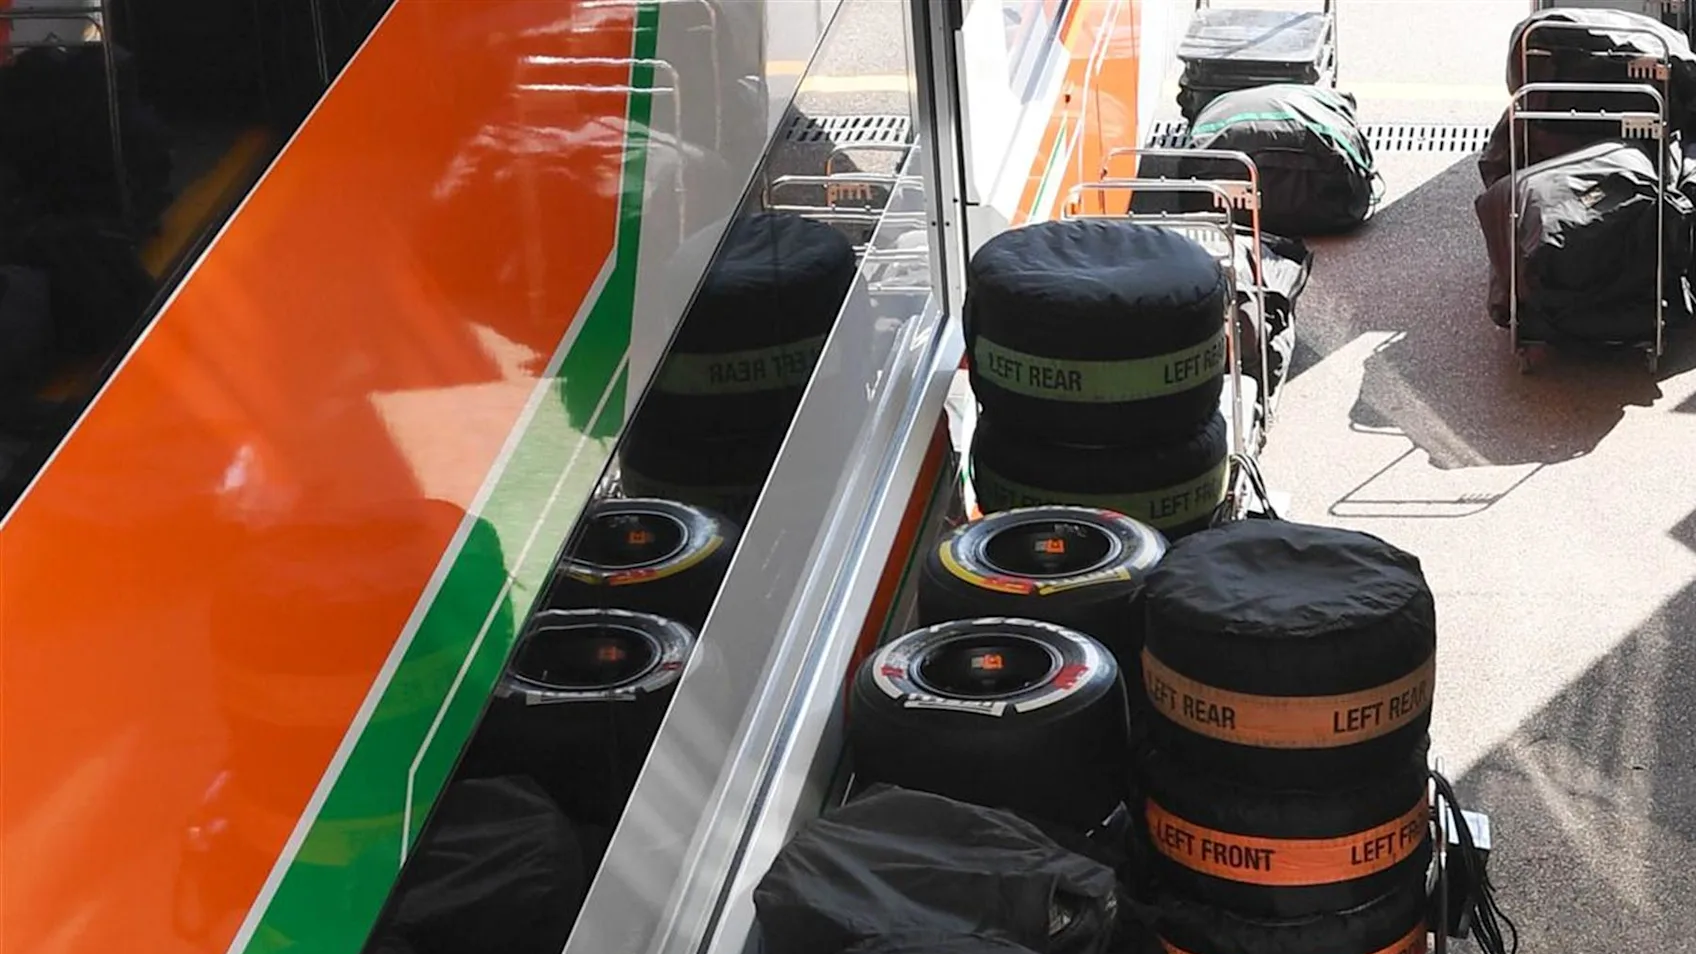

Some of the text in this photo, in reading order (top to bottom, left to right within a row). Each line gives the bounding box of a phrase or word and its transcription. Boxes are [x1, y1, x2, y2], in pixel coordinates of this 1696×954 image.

[988, 352, 1082, 391] LEFT REAR
[1164, 354, 1201, 384] LEFT
[1183, 693, 1236, 730] REAR
[1333, 679, 1426, 734] LEFT REAR
[1157, 818, 1276, 872] LEFT FRONT
[1351, 831, 1396, 866] LEFT
